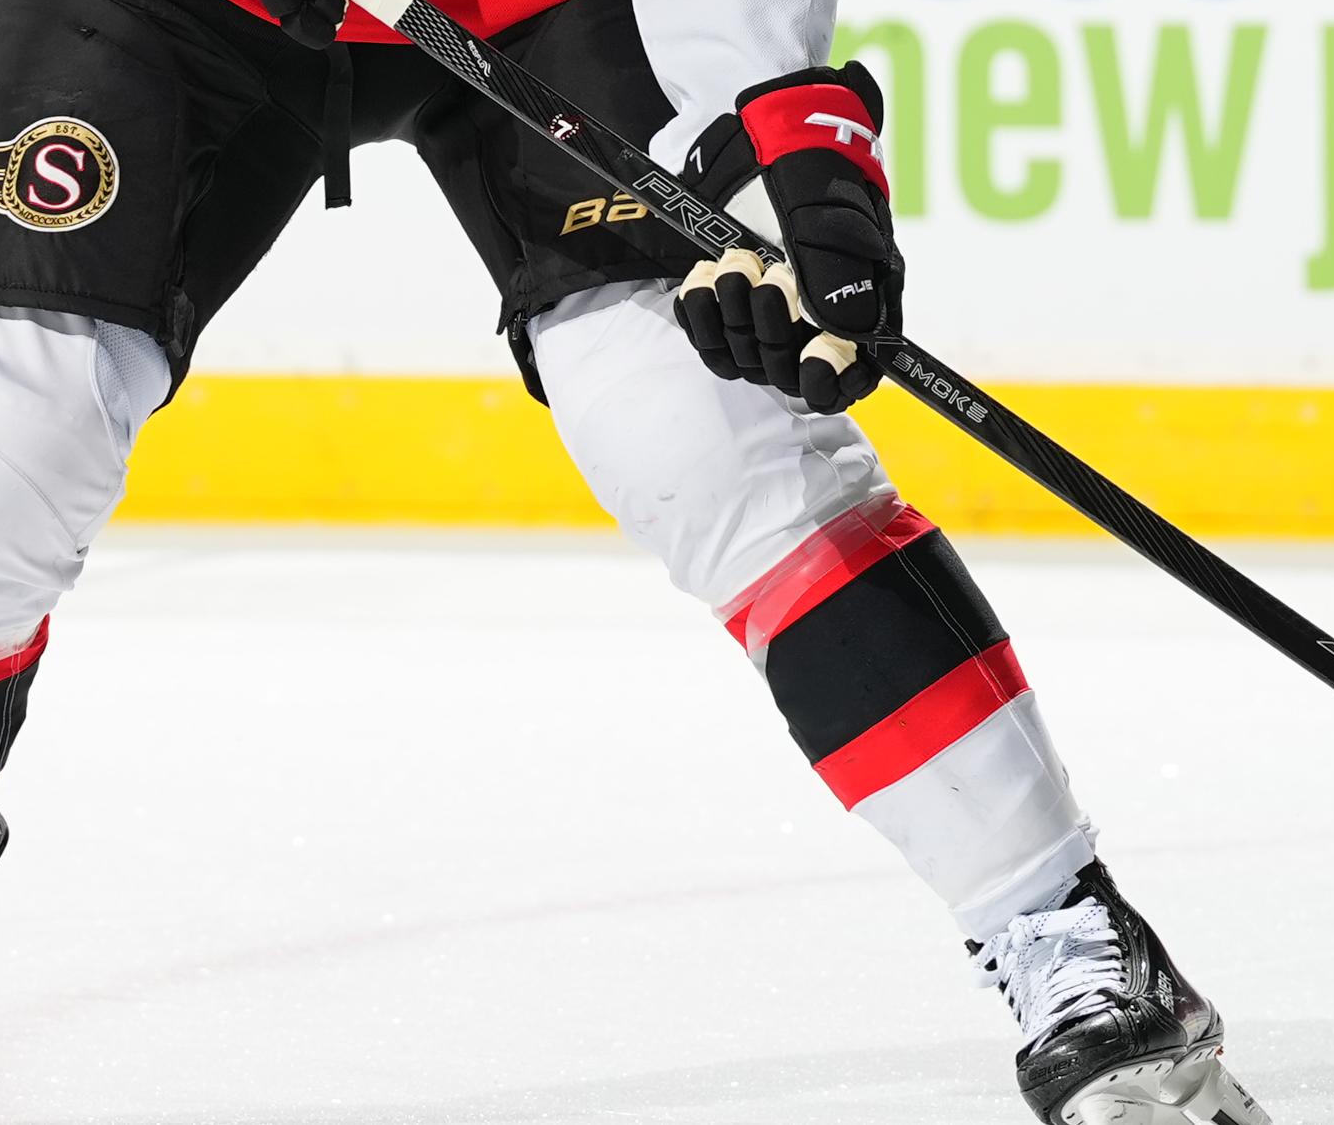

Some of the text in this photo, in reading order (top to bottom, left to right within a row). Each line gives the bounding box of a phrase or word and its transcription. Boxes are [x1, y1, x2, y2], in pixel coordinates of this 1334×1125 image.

[55, 124, 81, 137] EST.
[27, 142, 86, 211] S
[824, 279, 874, 304] TRUE
[892, 351, 988, 424] SMOKE
